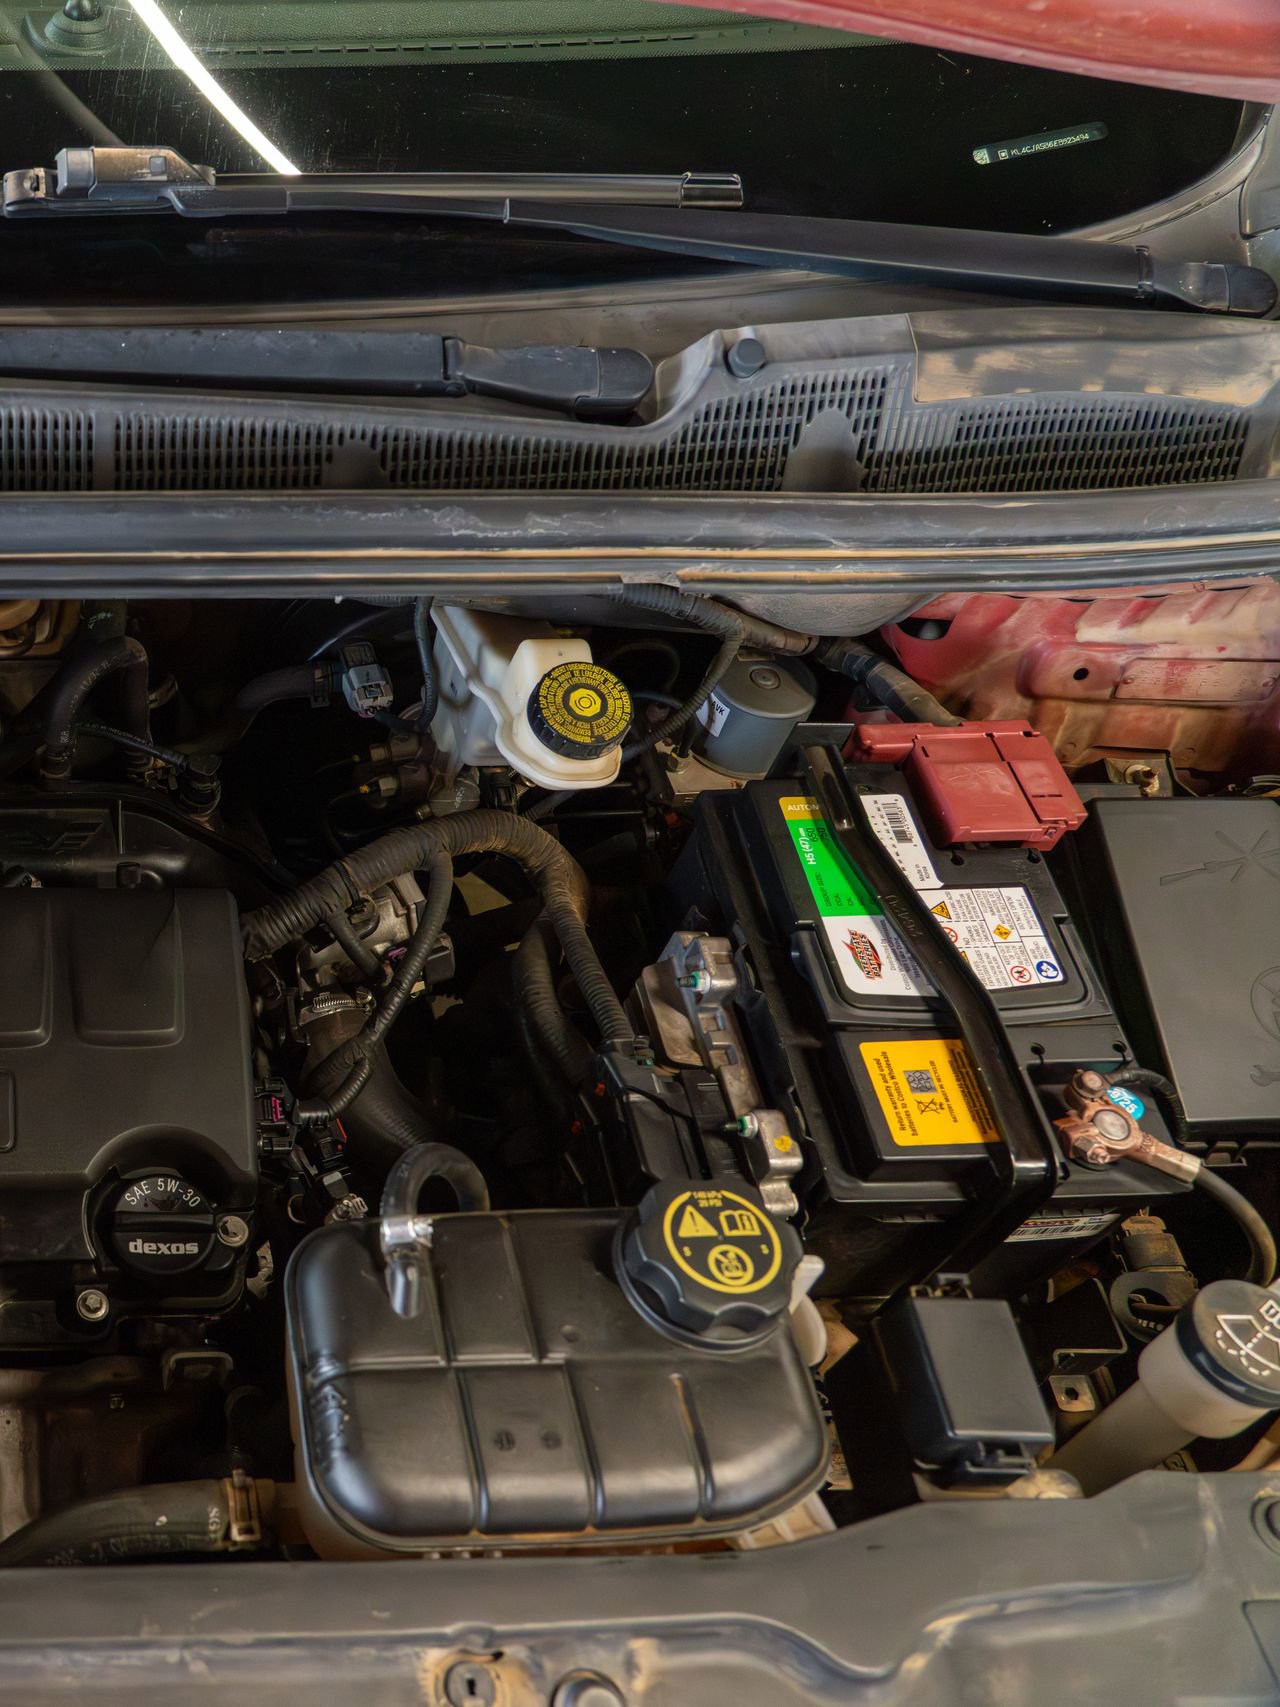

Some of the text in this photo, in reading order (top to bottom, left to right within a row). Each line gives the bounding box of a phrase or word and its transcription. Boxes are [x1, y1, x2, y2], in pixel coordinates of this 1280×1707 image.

[799, 838, 813, 851] (47)
[807, 828, 817, 842] 650
[805, 853, 816, 864] H5
[916, 869, 925, 881] Made
[921, 866, 930, 879] Korea
[1012, 911, 1022, 921] NOT
[962, 937, 971, 945] NO
[847, 928, 874, 978] INTERSTATE
[858, 934, 882, 977] BATTERIES
[879, 1050, 897, 1080] Wholesale
[928, 1060, 942, 1082] RECYCLED
[872, 1057, 906, 1130] Return warranty and used
[890, 1080, 905, 1101] Costco
[946, 1103, 958, 1122] BATTERY
[902, 1110, 918, 1136] batteries
[125, 1178, 201, 1208] SAE 5W-30
[129, 1239, 198, 1254] dexos
